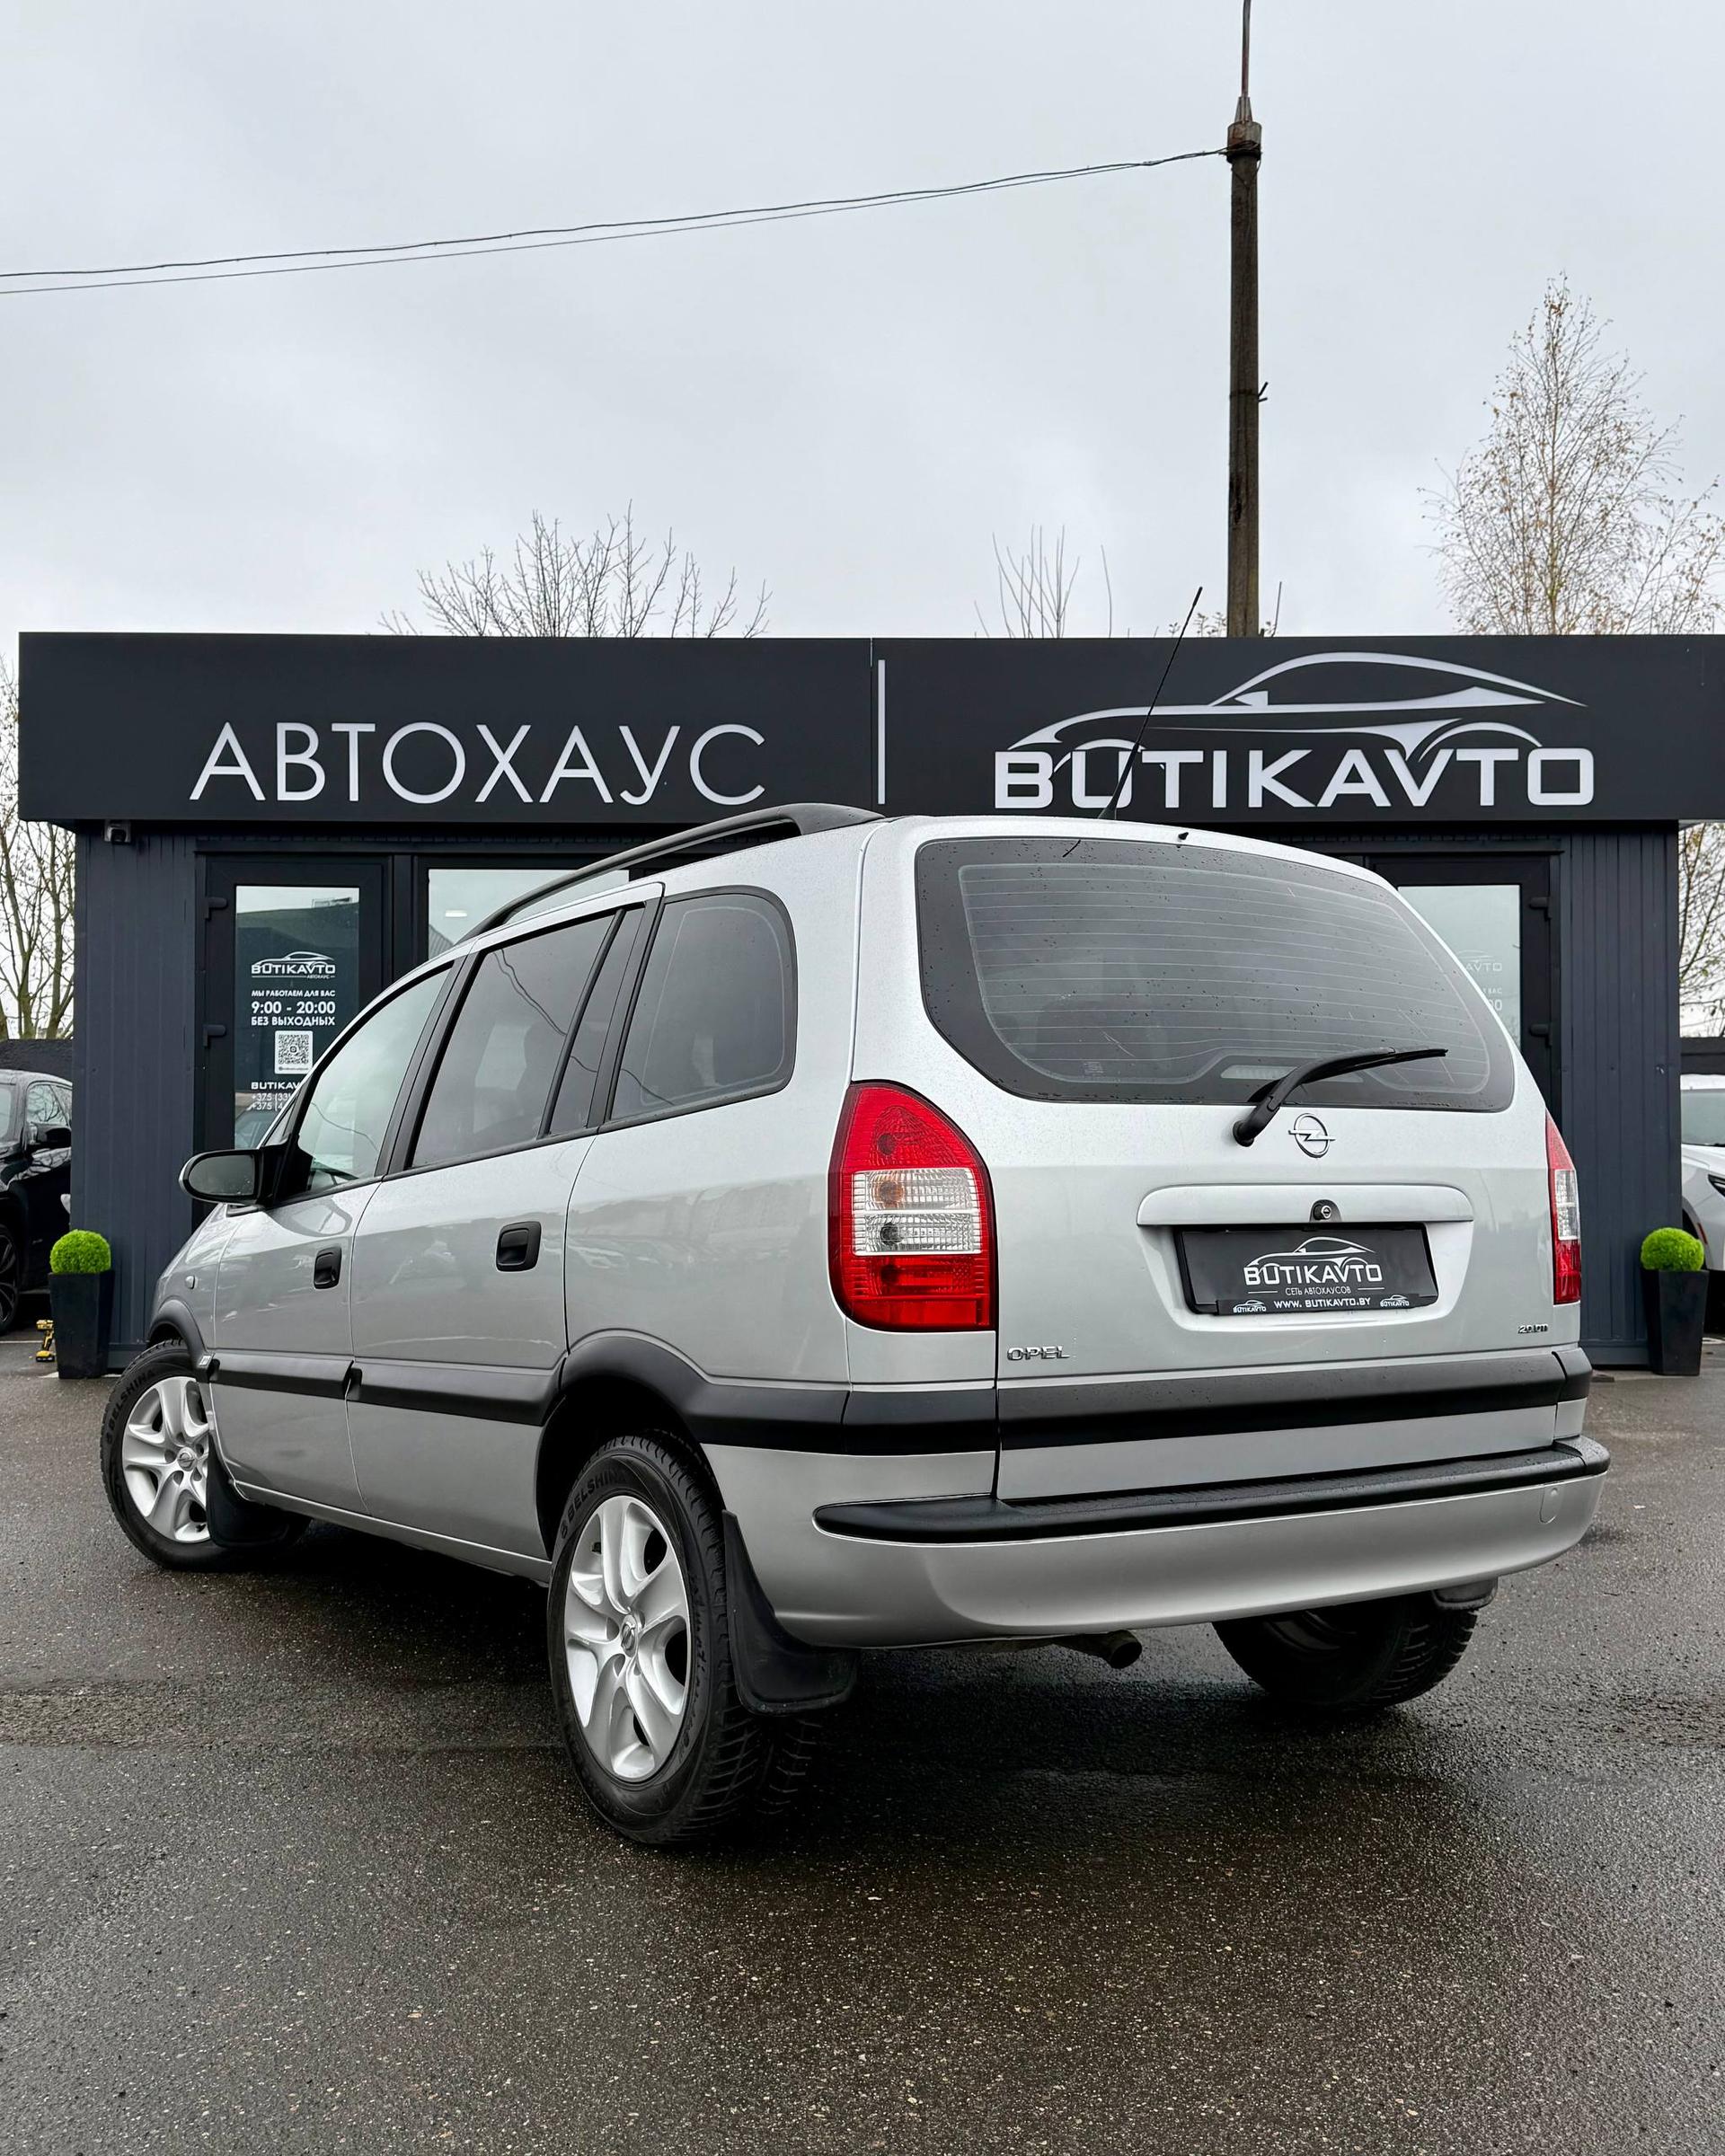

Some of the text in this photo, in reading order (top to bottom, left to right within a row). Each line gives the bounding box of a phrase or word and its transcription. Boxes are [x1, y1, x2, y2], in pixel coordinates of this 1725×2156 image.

[190, 721, 765, 806] АВТОХАУС
[995, 747, 1595, 808] BUTIKAVTO
[251, 964, 336, 975] BUTIKAVTO
[1465, 962, 1503, 972] AVTO
[304, 990, 320, 998] ДЛЯ
[251, 1001, 282, 1014] 9:00
[296, 1001, 336, 1014] 20:00
[251, 1016, 336, 1028] БЕЗ ВЫХОДНЫХ
[251, 1082, 301, 1090] BUTIKAV
[1243, 1264, 1383, 1286] BUTIKAVTO
[1285, 1286, 1351, 1296] СЕТЬ АВТОХАУСОВ
[1233, 1305, 1267, 1313] BUTIKAVTO
[1007, 1346, 1071, 1361] OPEL
